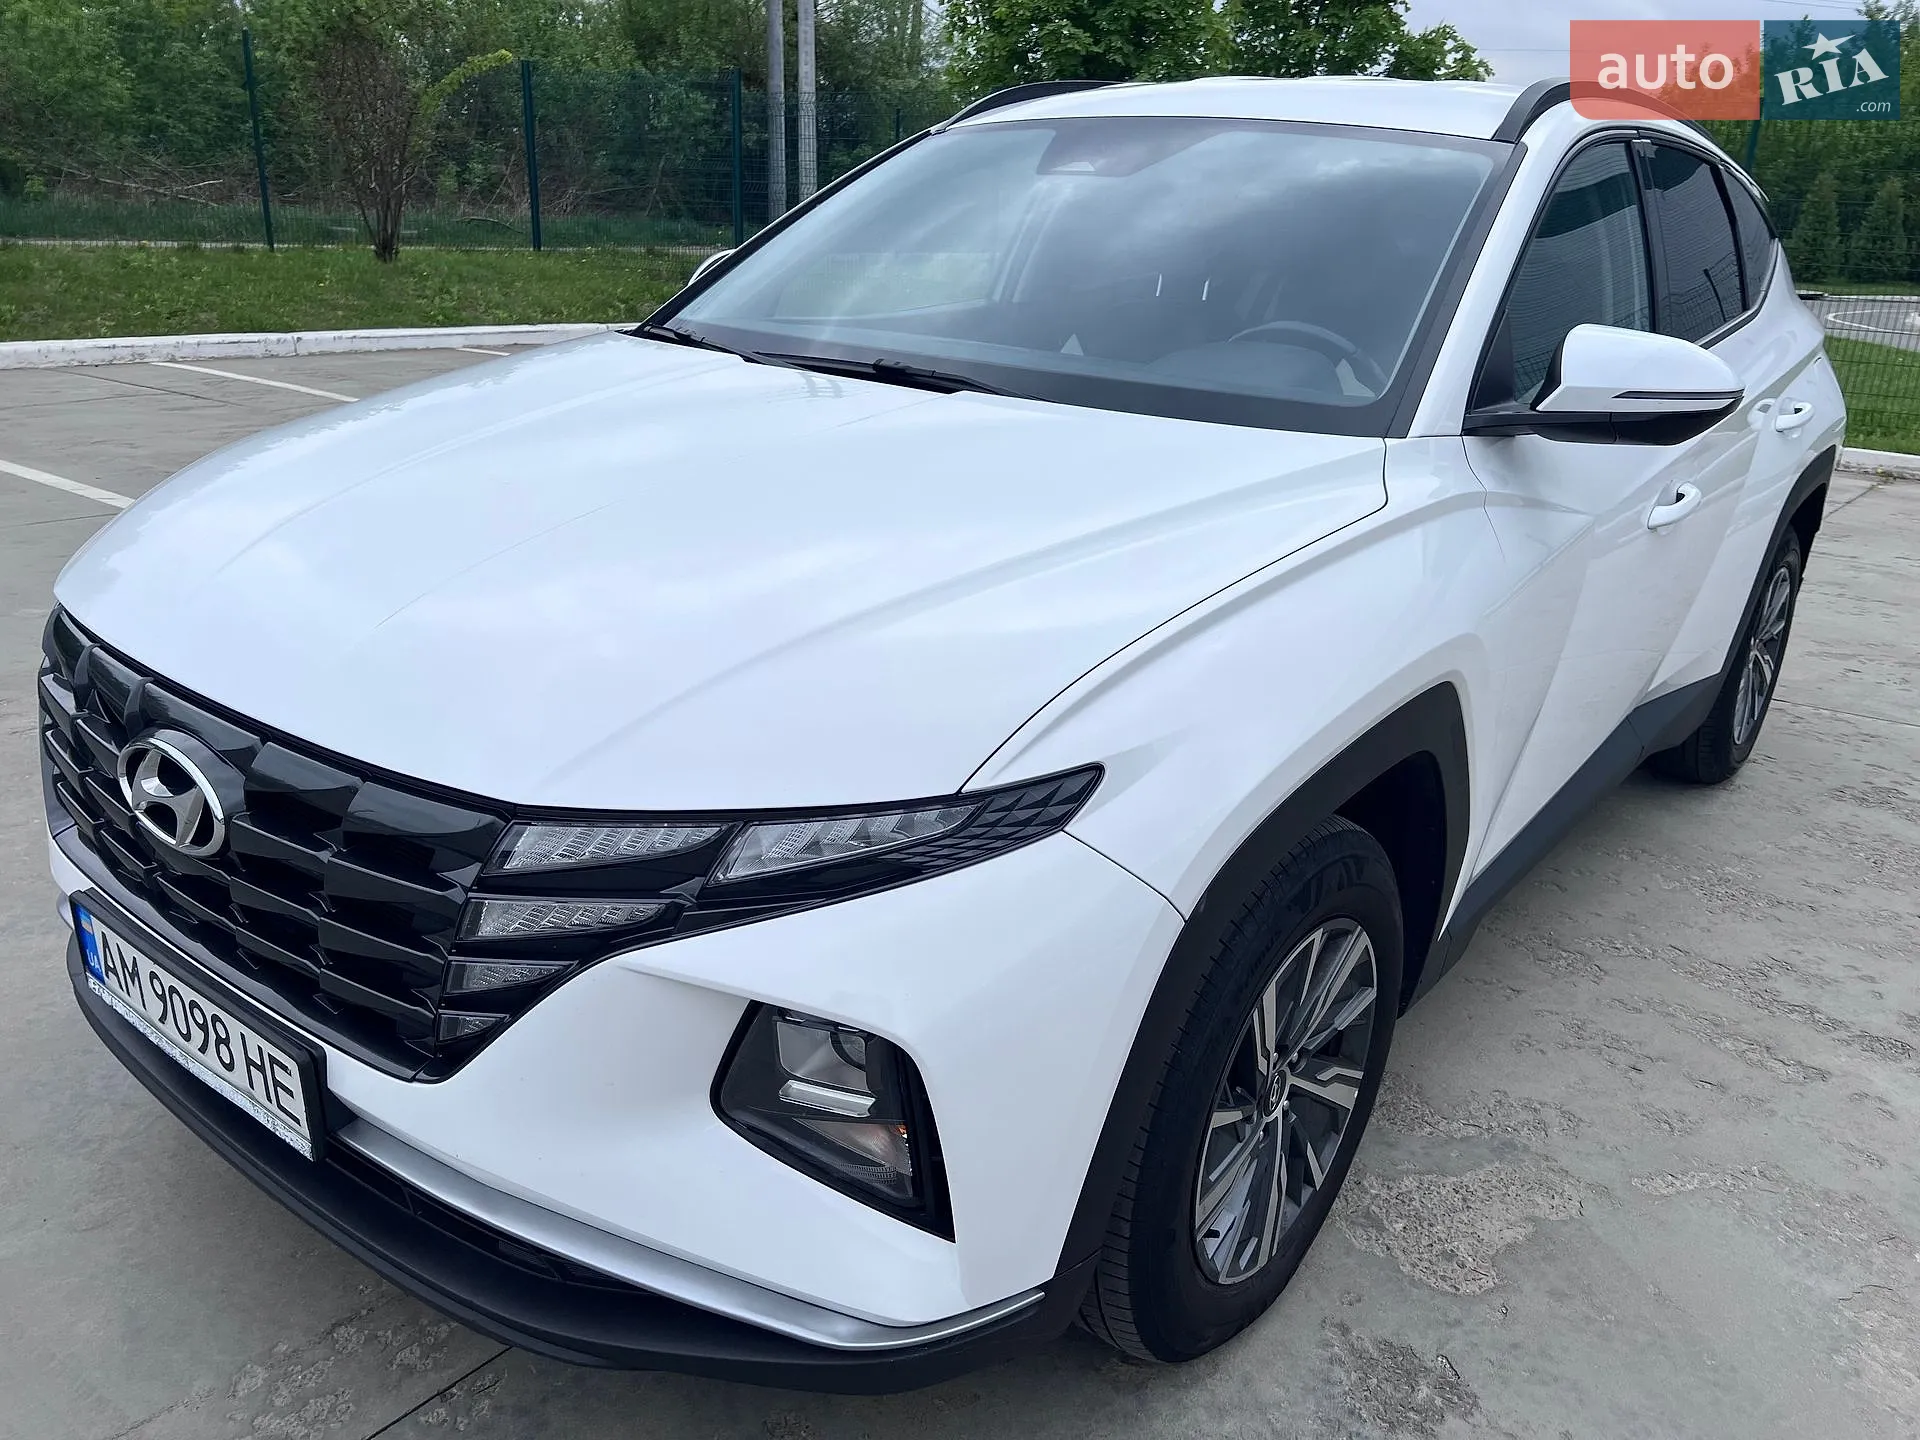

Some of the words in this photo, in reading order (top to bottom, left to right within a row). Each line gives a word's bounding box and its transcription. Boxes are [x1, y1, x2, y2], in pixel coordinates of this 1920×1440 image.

[86, 948, 102, 973] UA
[101, 931, 147, 1011] AM
[149, 970, 235, 1073] 9098
[240, 1031, 302, 1127] HE
